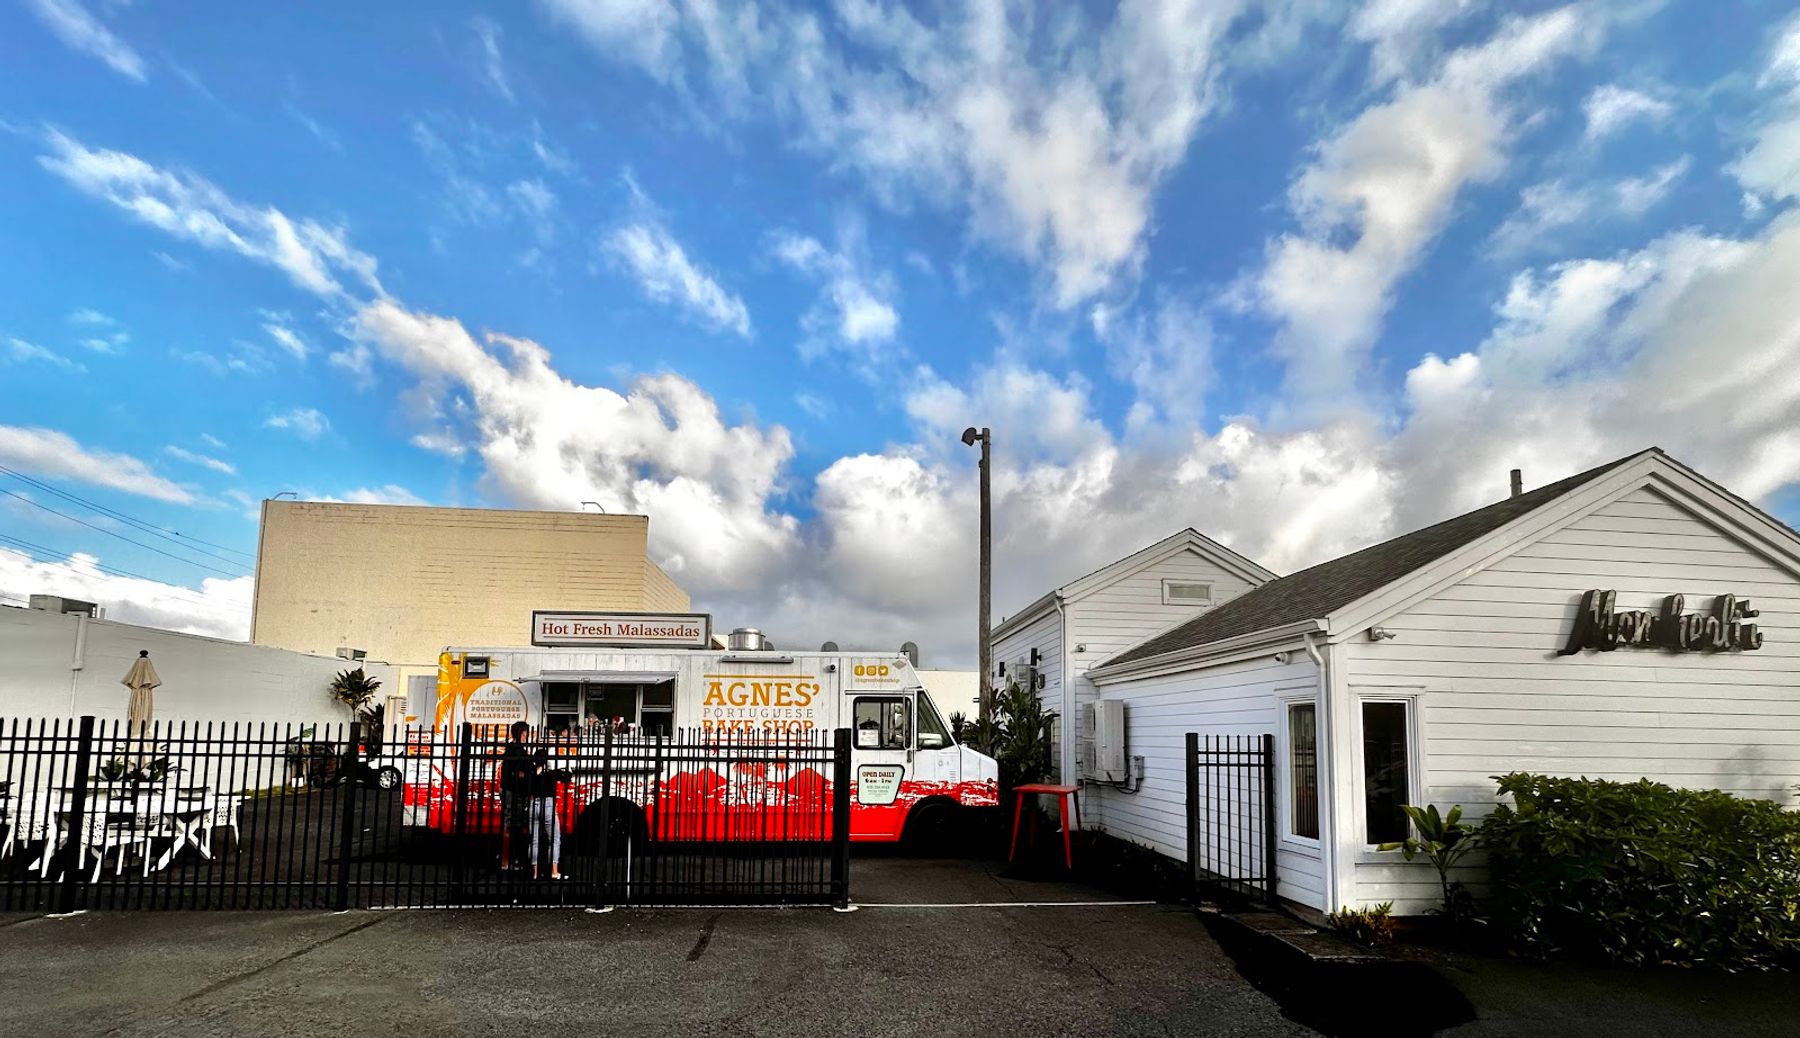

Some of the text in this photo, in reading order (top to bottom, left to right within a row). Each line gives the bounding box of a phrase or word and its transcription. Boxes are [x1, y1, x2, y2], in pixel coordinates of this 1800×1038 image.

[542, 623, 700, 637] Hot Fresh Malassadas
[703, 681, 820, 707] AGNES'
[703, 708, 814, 718] PORTUGUESE
[702, 720, 814, 735] BAKE SHOP
